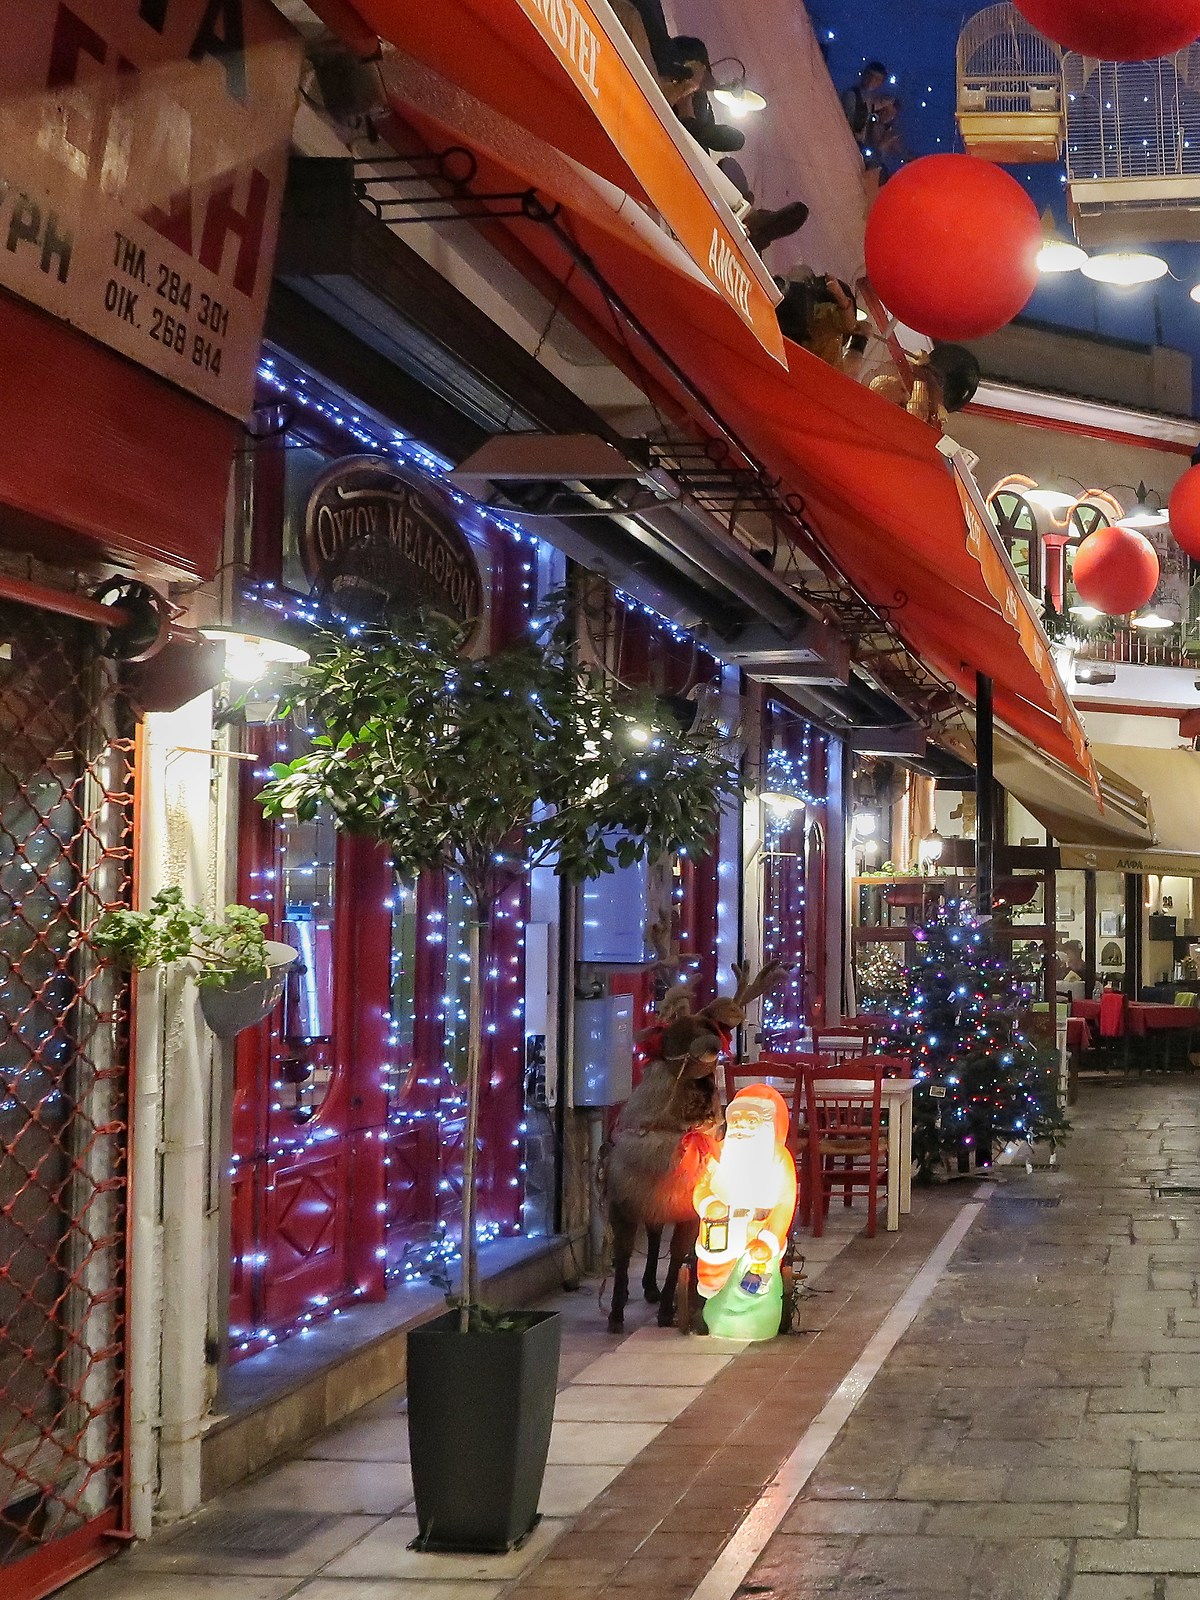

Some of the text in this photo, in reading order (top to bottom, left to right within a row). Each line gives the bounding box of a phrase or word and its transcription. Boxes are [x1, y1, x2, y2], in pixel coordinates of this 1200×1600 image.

[157, 263, 191, 313] 284
[197, 293, 229, 337] 301
[709, 228, 754, 324] AMSTEL
[149, 309, 186, 355] 268
[192, 335, 222, 377] 814
